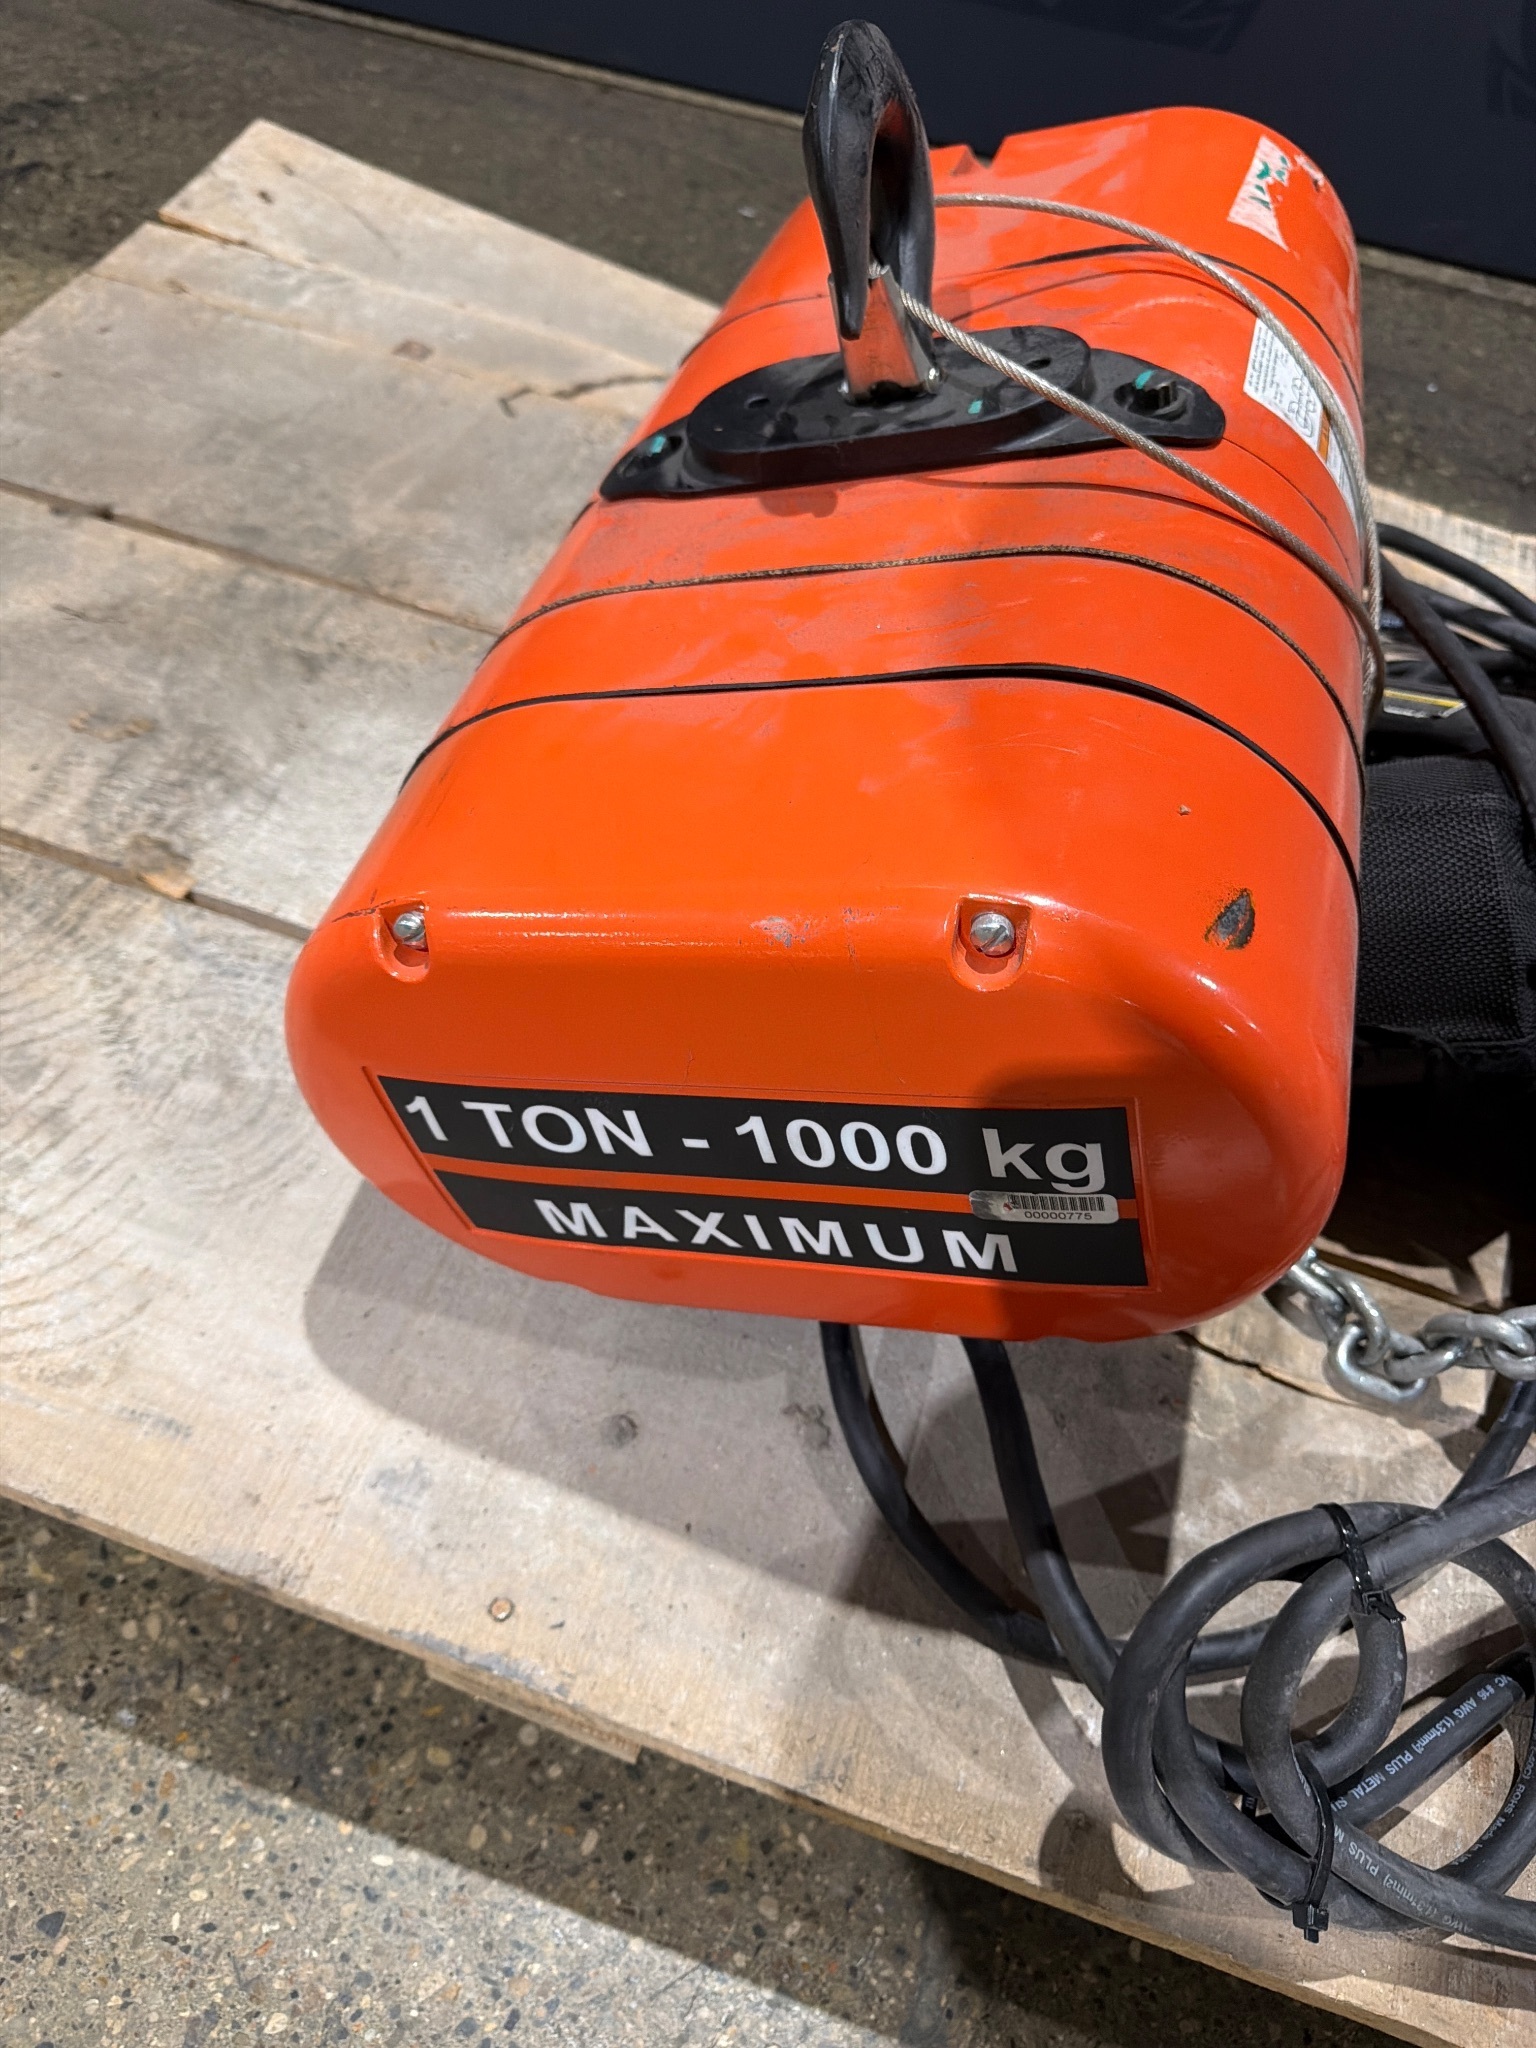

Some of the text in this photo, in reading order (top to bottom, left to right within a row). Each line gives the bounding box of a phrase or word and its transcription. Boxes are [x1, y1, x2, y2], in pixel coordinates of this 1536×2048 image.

[404, 1094, 449, 1142] 1
[461, 1100, 654, 1158] TON
[734, 1115, 949, 1177] 1000
[983, 1128, 1106, 1194] kg
[1024, 1211, 1093, 1221] 00000775
[534, 1198, 1019, 1274] MAXIMUM
[1454, 1697, 1478, 1718] AWG
[1385, 1750, 1413, 1775] PLUS
[1353, 1771, 1386, 1800] METAL
[1504, 1784, 1526, 1814] ROHS
[1348, 1841, 1379, 1877] PLUS
